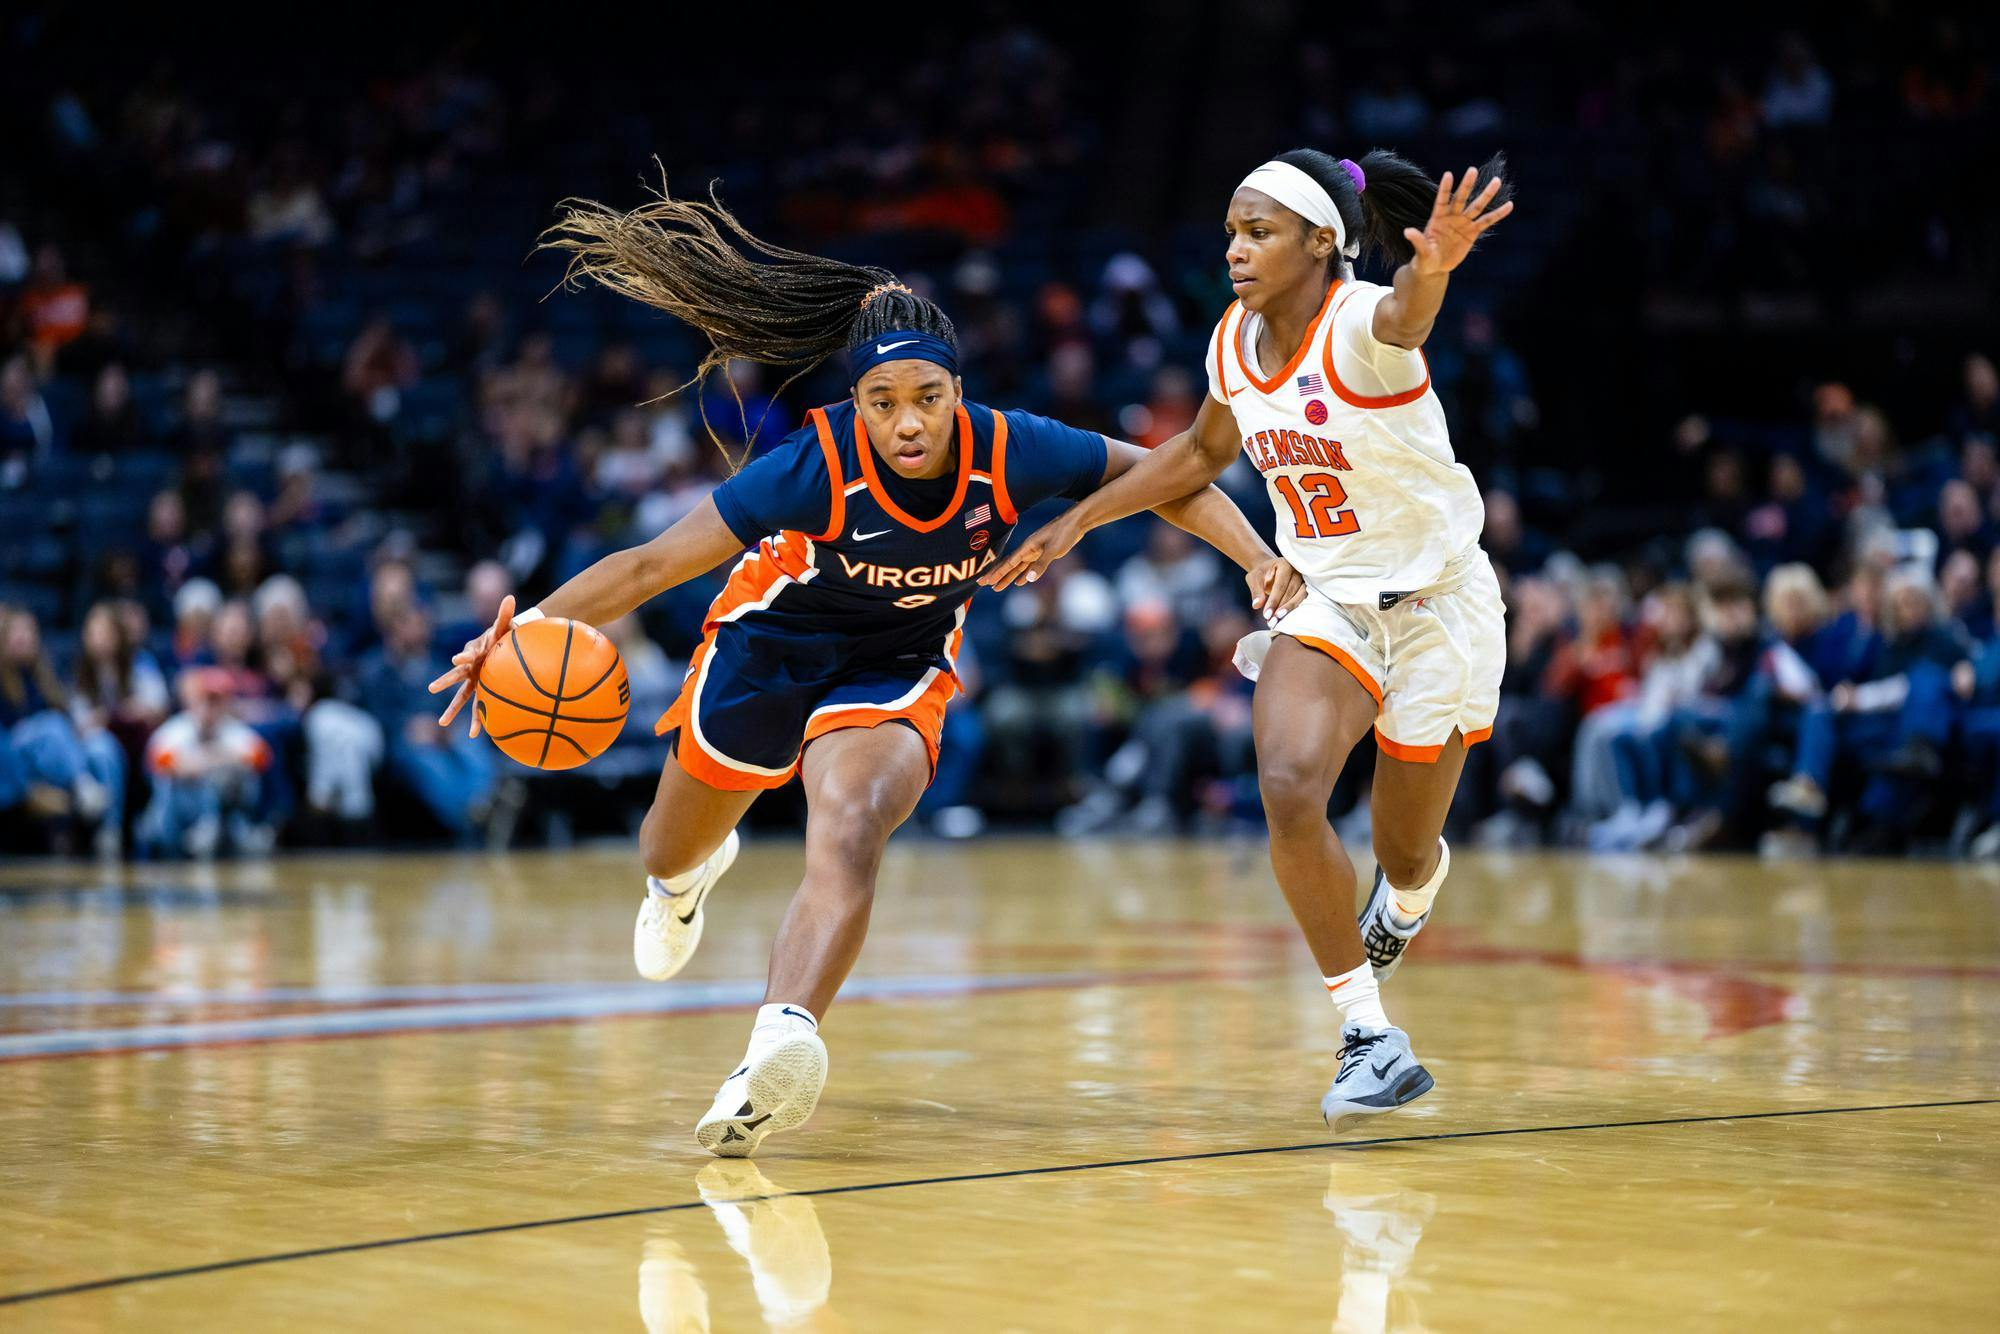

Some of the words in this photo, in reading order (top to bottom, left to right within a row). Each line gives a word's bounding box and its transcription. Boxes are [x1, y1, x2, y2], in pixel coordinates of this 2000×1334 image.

[1244, 429, 1353, 472] LEMSON
[1274, 472, 1361, 538] 12
[837, 548, 997, 588] VIRGINIA
